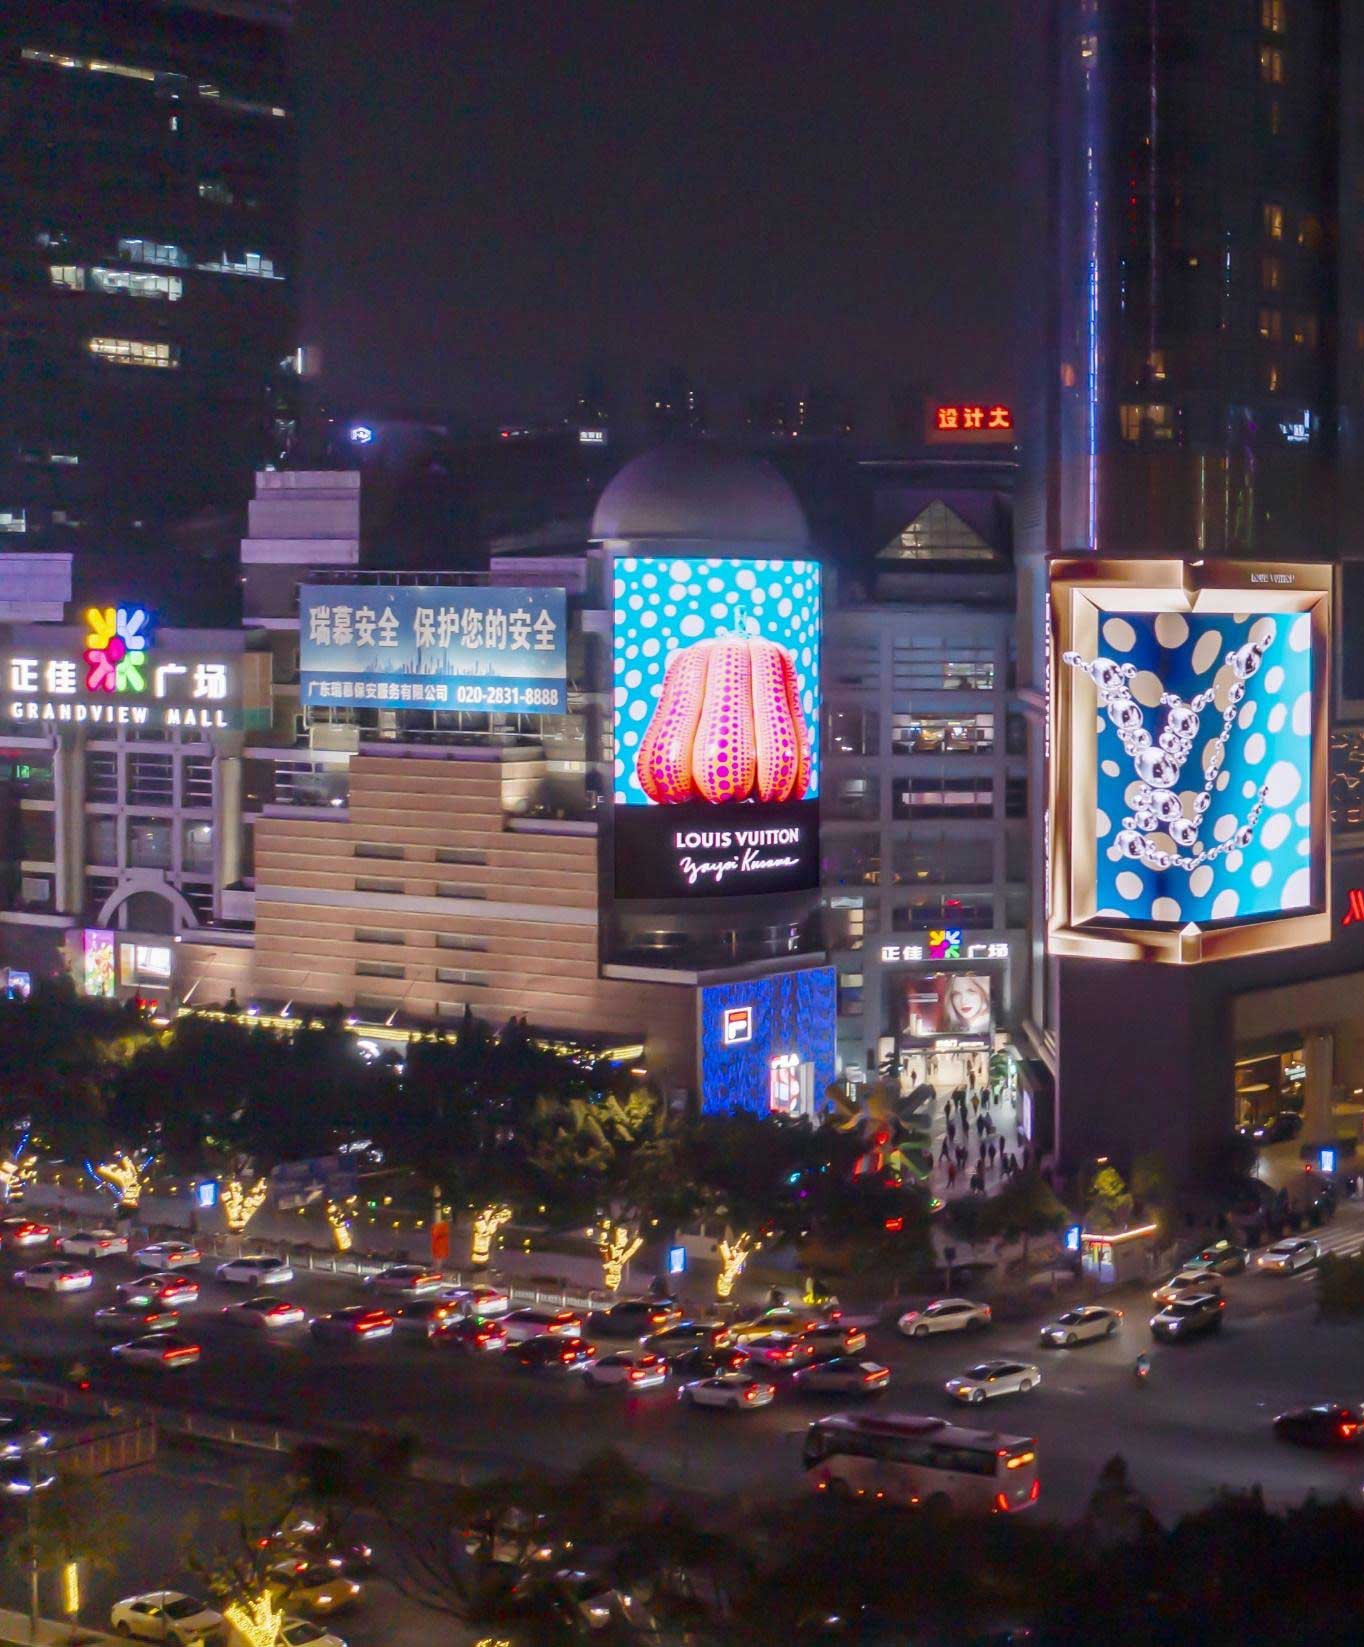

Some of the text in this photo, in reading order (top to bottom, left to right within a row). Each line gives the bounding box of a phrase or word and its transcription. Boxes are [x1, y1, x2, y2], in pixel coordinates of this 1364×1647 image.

[938, 406, 1010, 429] 设计大
[413, 606, 557, 651] 保护您的安全
[457, 685, 559, 706] 020-2831-8888
[11, 701, 229, 728] GRANDVIEW MALL
[675, 826, 800, 849] LOUIS VUITTON
[770, 1053, 800, 1070] FILA
